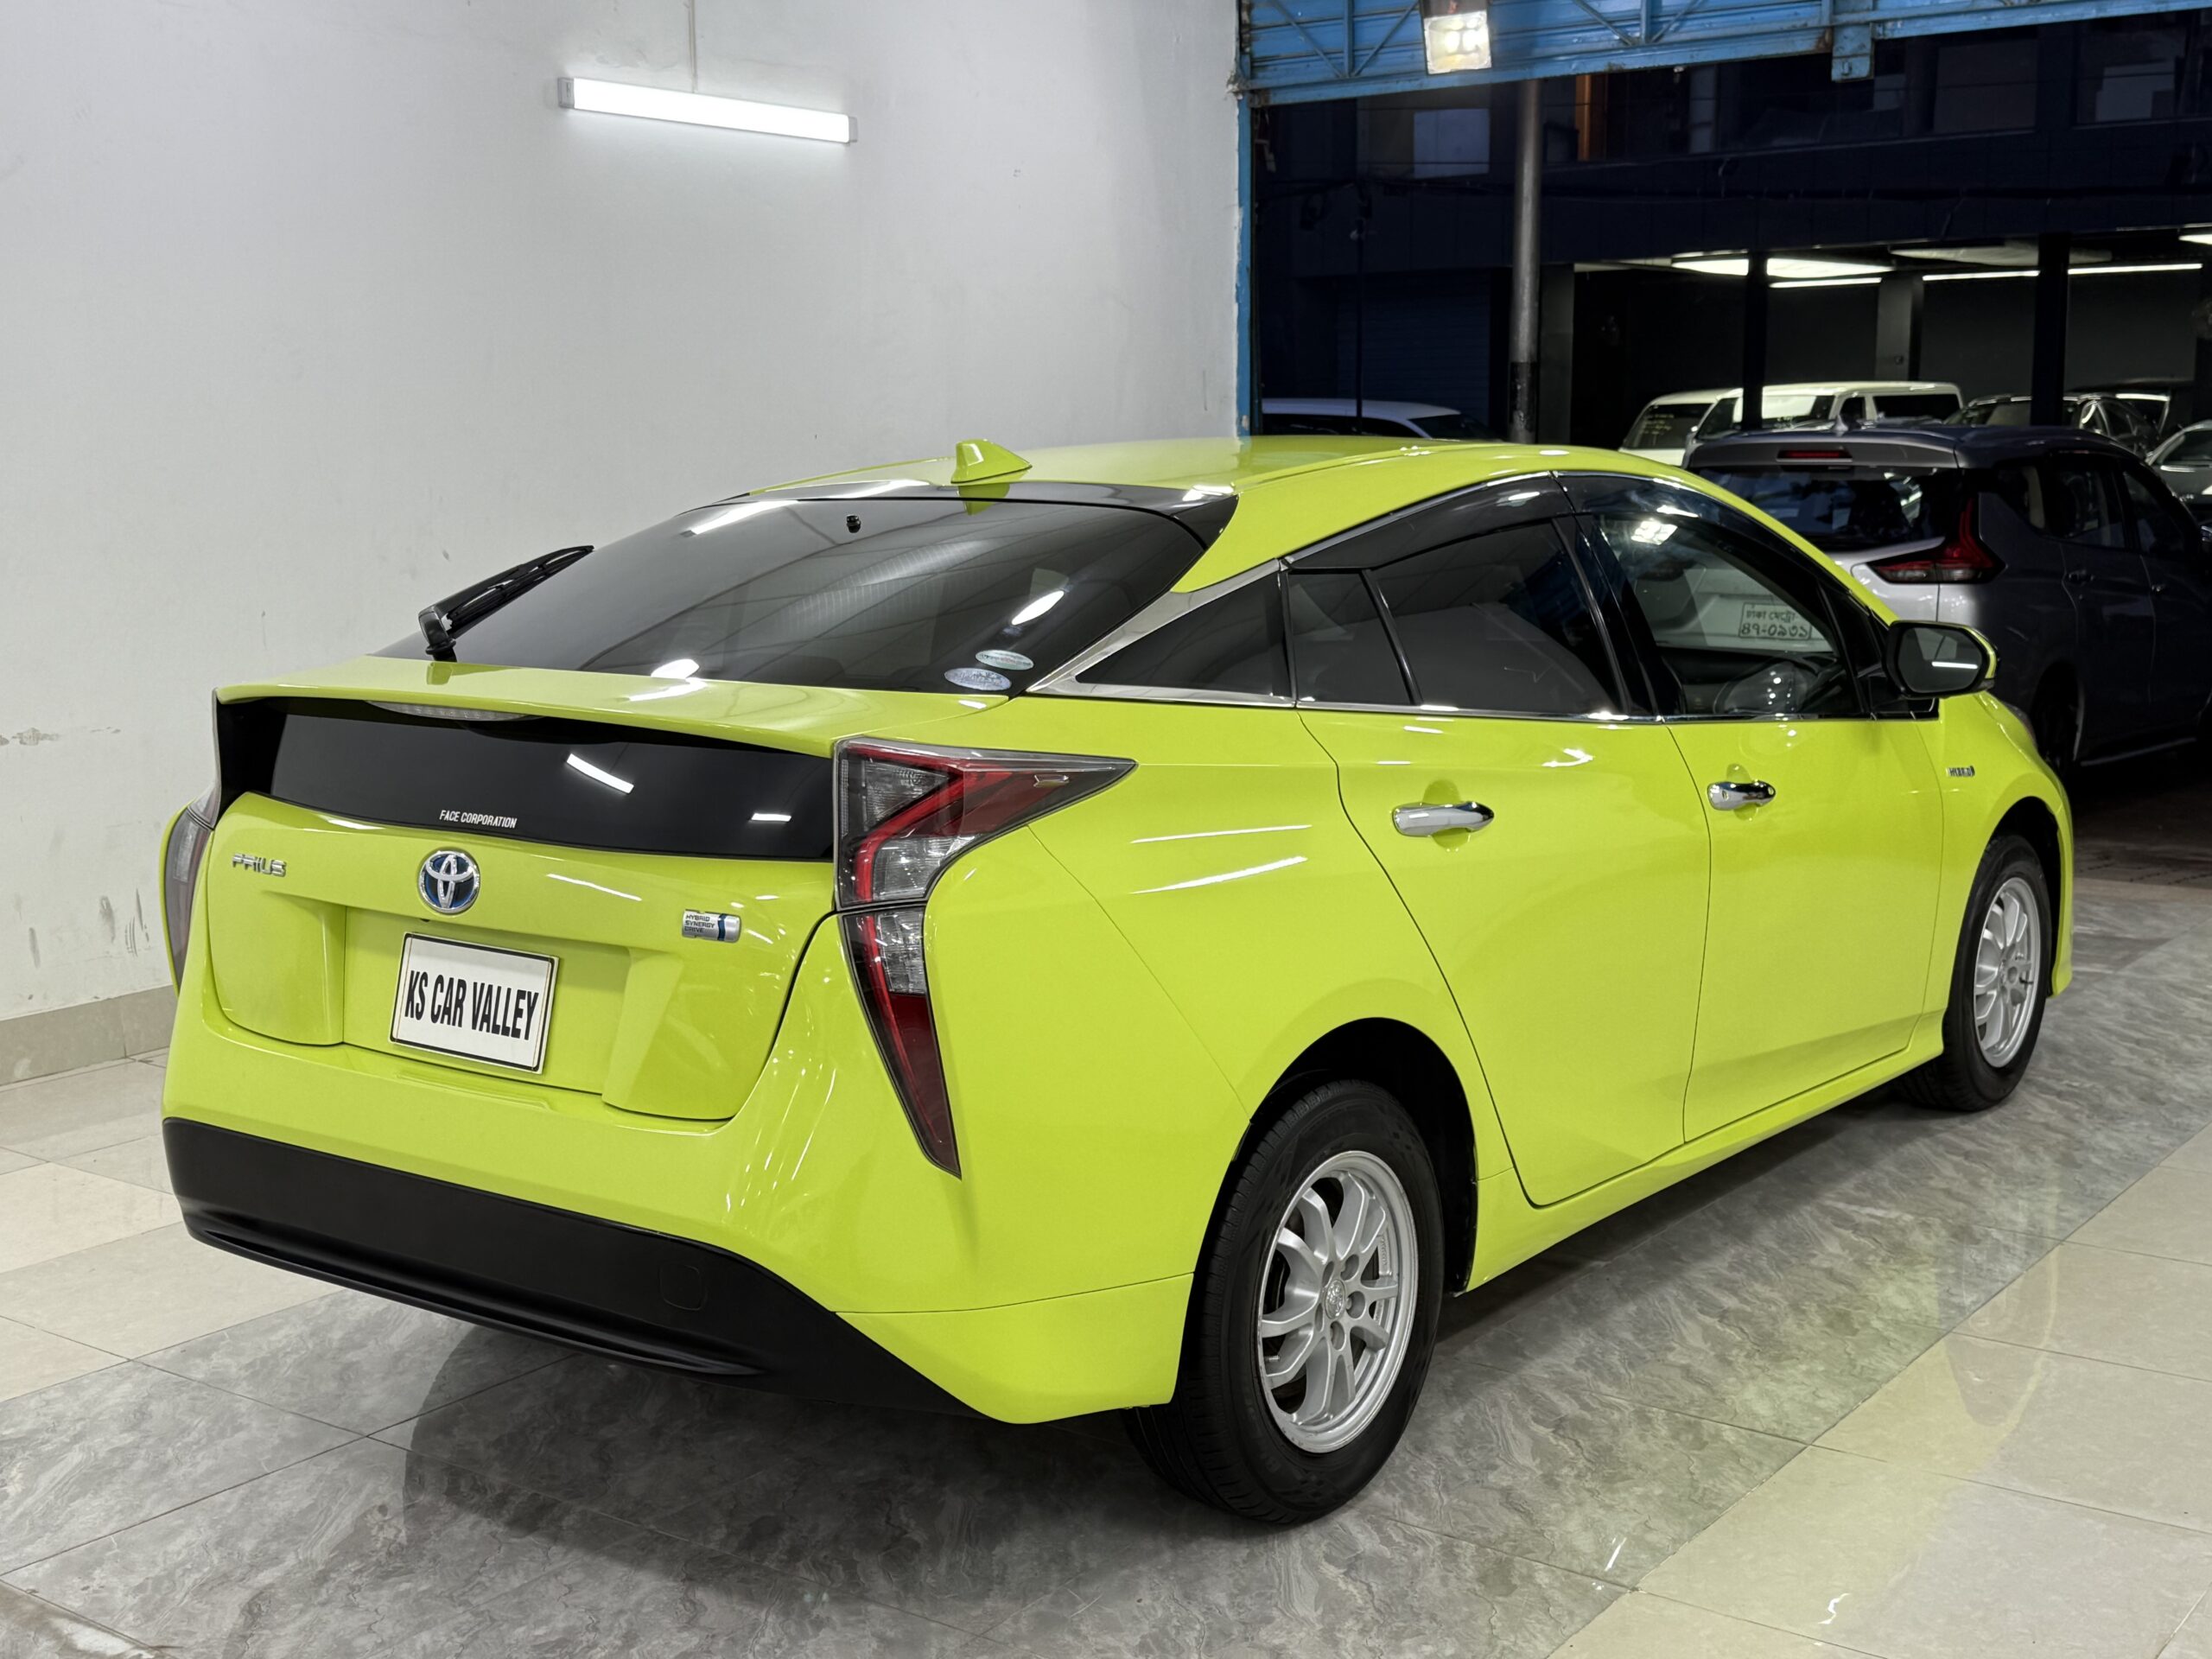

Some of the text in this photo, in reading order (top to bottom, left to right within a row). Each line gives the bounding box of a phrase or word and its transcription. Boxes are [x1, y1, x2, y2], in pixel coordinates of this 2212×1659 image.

[439, 810, 518, 829] FACE CORPORATION
[232, 853, 288, 878] PRIUS
[684, 920, 715, 929] SYNERGY
[404, 969, 540, 1041] KS CAR VALLEY
